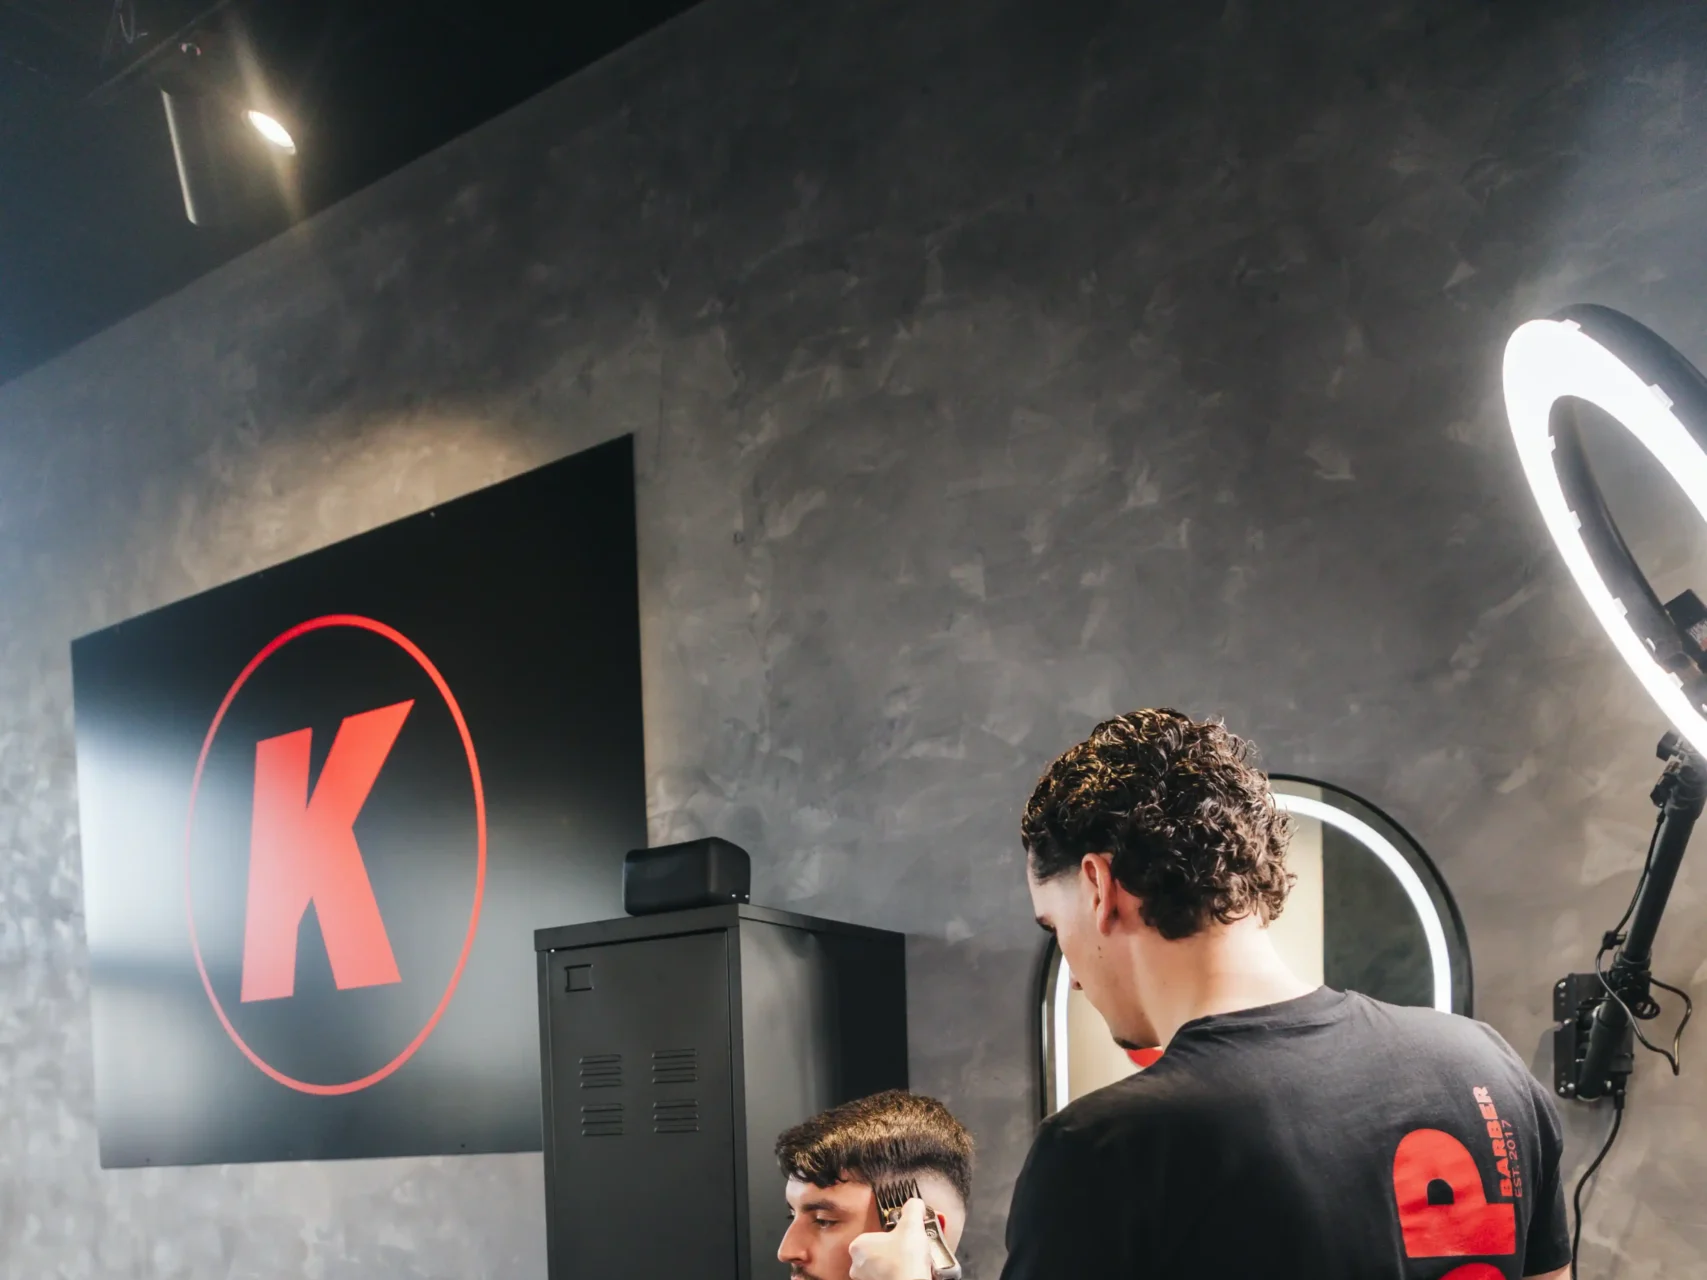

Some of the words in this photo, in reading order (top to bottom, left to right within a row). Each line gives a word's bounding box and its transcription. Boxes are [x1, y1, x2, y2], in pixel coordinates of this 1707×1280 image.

[241, 699, 414, 1003] K
[1472, 1086, 1513, 1197] BARBER
[1501, 1119, 1518, 1161] 2017
[1512, 1166, 1523, 1198] EST.
